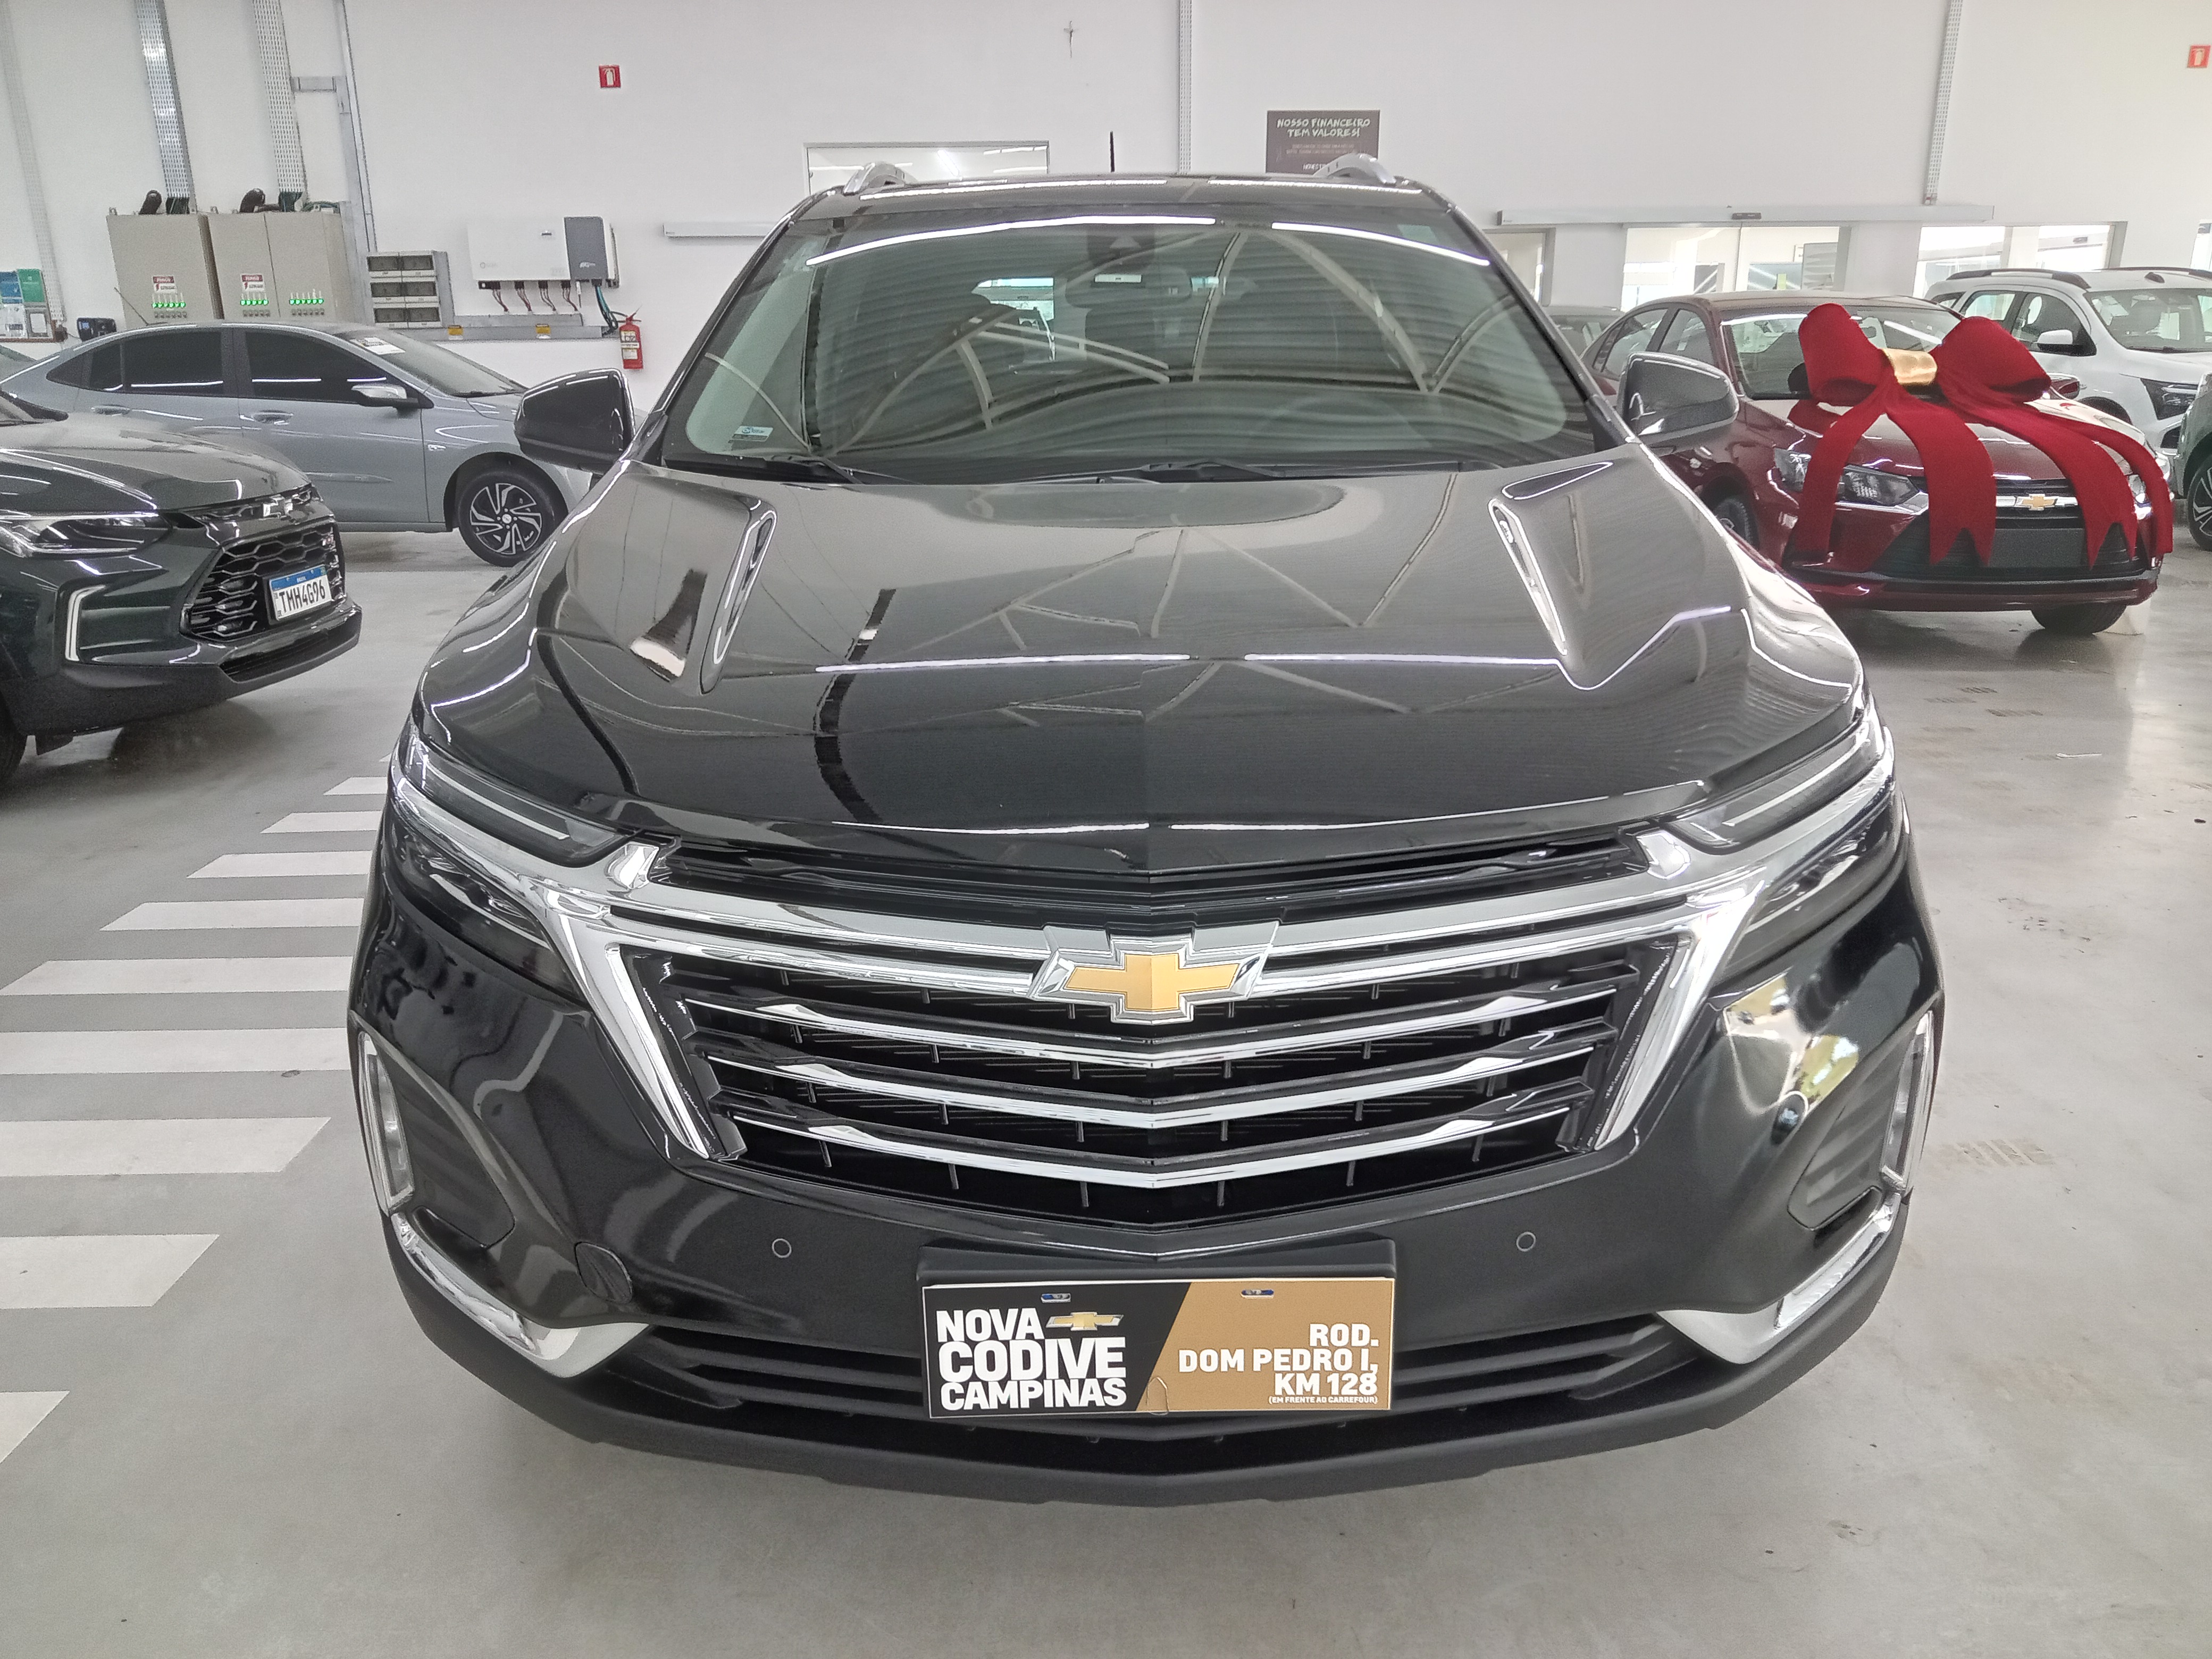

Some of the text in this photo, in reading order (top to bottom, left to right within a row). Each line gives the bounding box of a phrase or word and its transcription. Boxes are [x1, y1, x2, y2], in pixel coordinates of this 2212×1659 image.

[1277, 118, 1370, 128] NOSSO FINANCEIRO
[279, 580, 325, 613] TMH4G96
[936, 1308, 1044, 1342] NOVA
[1310, 1323, 1379, 1346] ROD.
[939, 1337, 1126, 1382] CODIVE
[1179, 1348, 1378, 1376] DOM PEDRO I,
[941, 1378, 1127, 1410] CAMPINAS
[1275, 1372, 1378, 1395] KM 128
